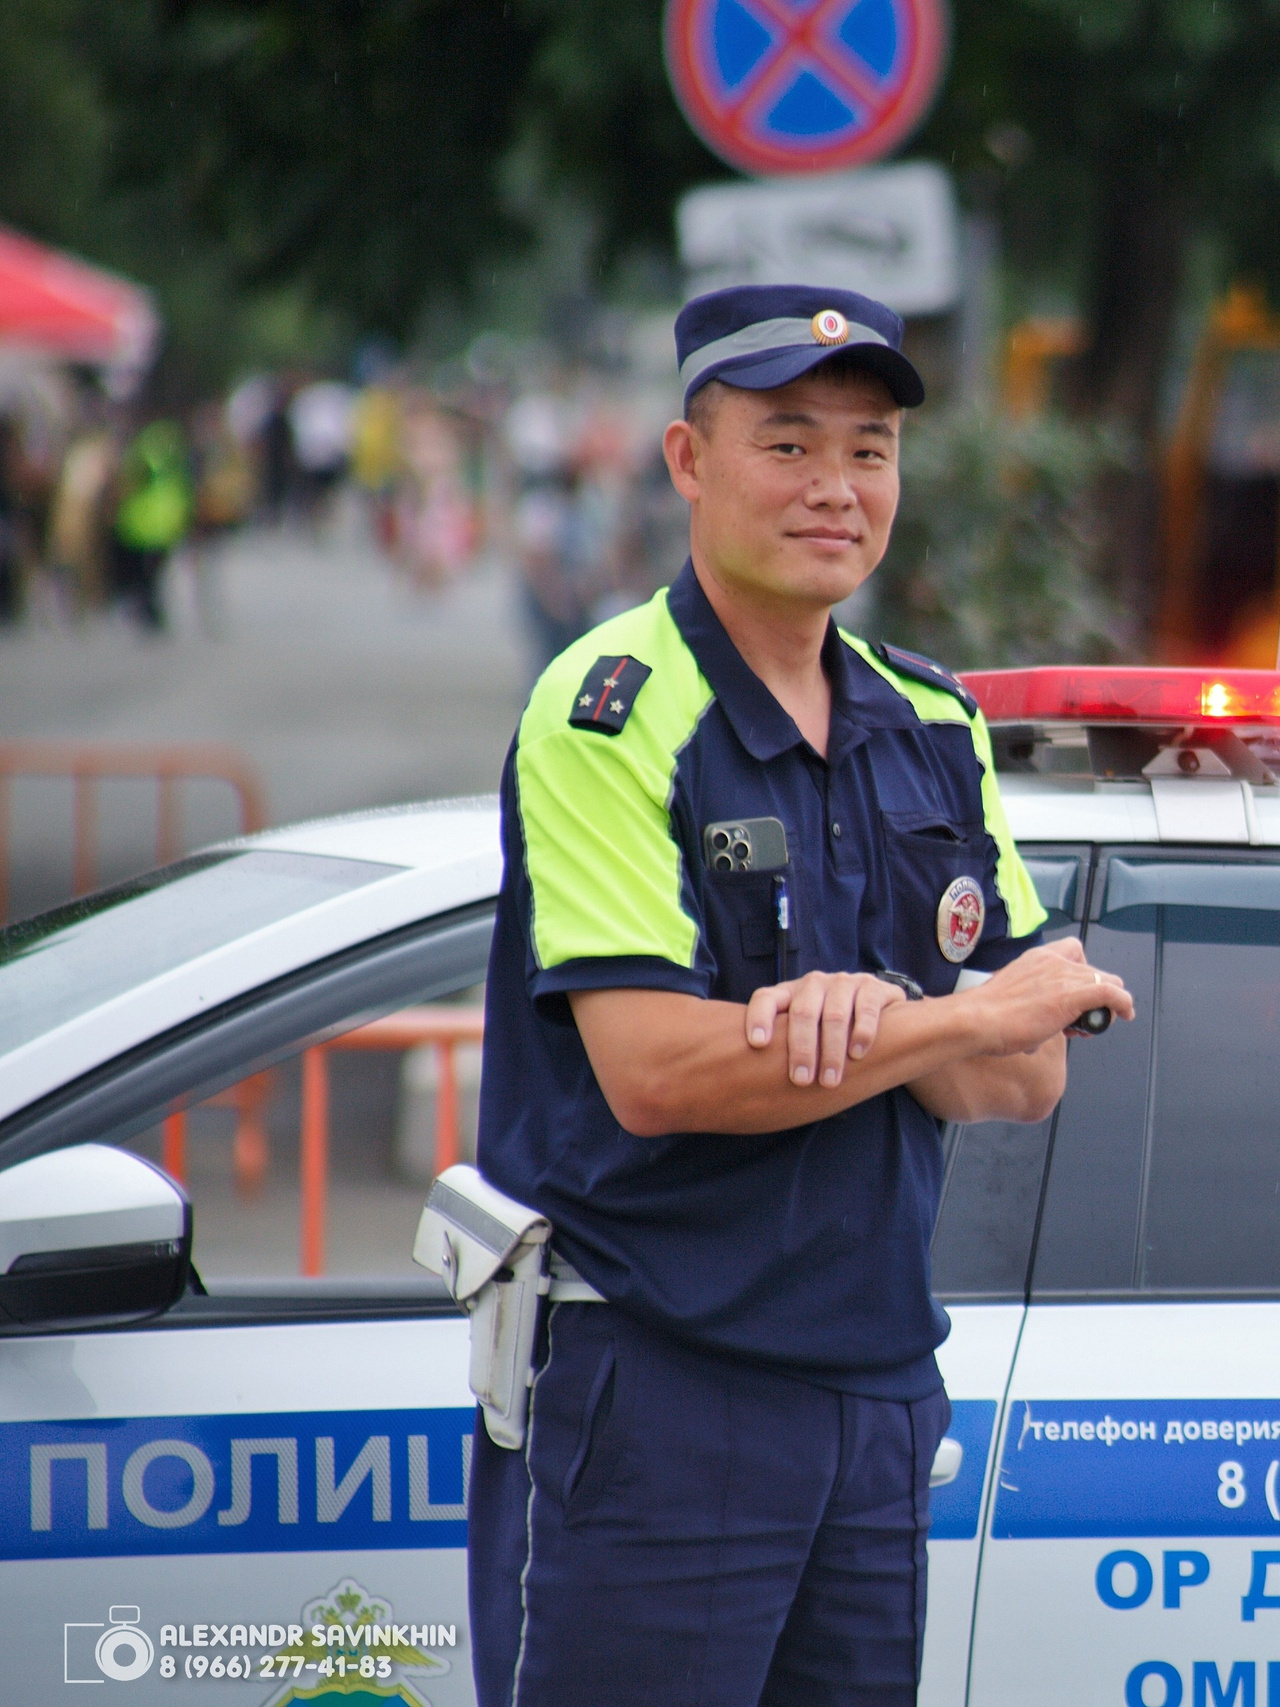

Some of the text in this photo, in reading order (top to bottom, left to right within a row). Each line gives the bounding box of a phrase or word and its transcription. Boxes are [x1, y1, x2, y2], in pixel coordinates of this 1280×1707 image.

[1031, 1414, 1157, 1447] телефон
[1217, 1460, 1246, 1508] 8
[1095, 1549, 1211, 1610] ОР
